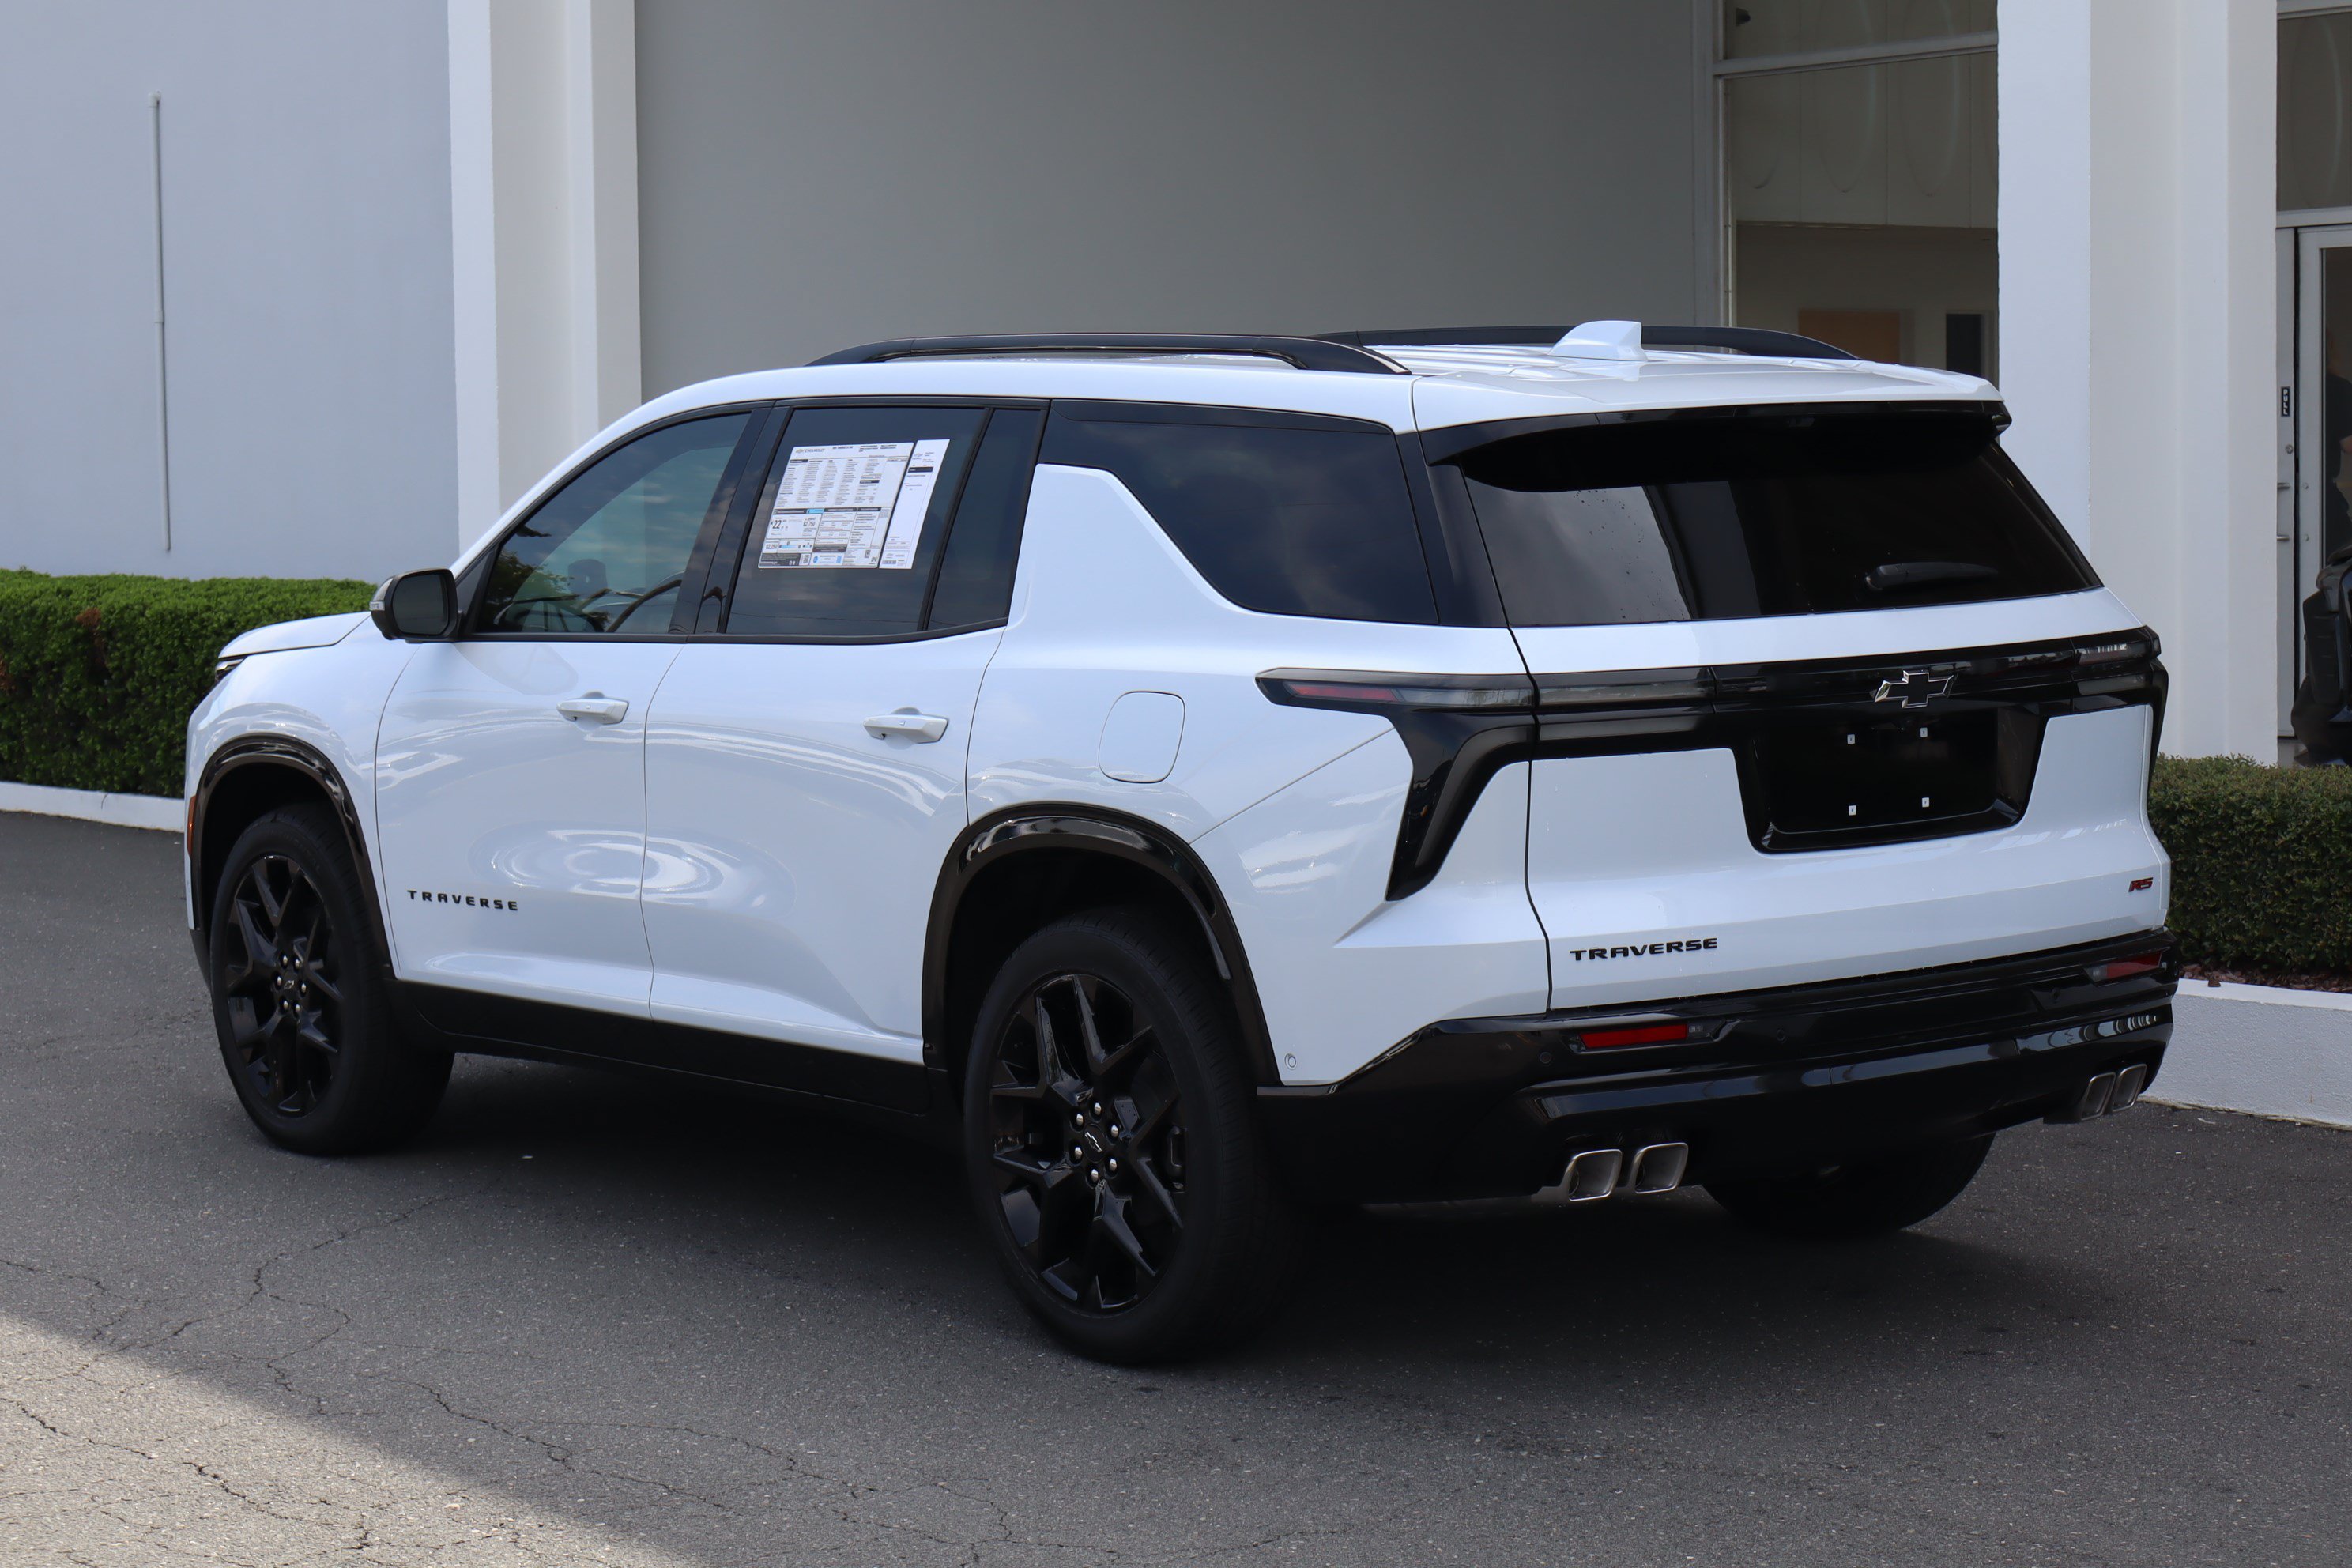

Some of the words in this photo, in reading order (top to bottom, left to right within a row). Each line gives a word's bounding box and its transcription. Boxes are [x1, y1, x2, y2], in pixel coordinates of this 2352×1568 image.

[2128, 877, 2154, 892] RS
[407, 890, 518, 911] TRAVERSE
[1570, 937, 1718, 961] TRAVERSE
